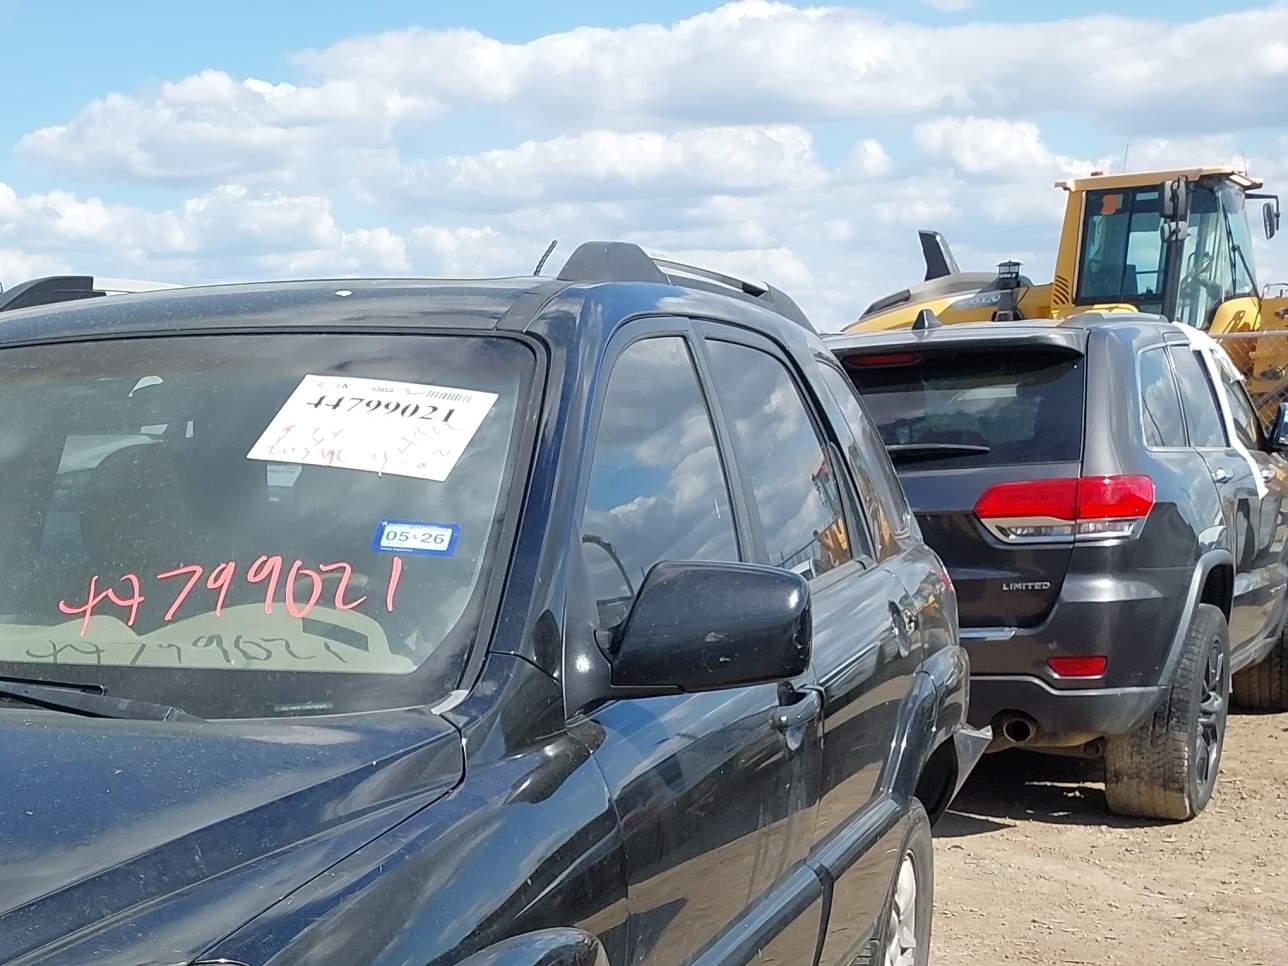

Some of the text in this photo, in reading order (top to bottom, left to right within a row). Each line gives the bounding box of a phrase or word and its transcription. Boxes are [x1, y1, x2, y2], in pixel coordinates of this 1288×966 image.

[306, 393, 458, 424] 44799021
[58, 554, 404, 637] 44799021
[1002, 581, 1052, 591] LIMITED
